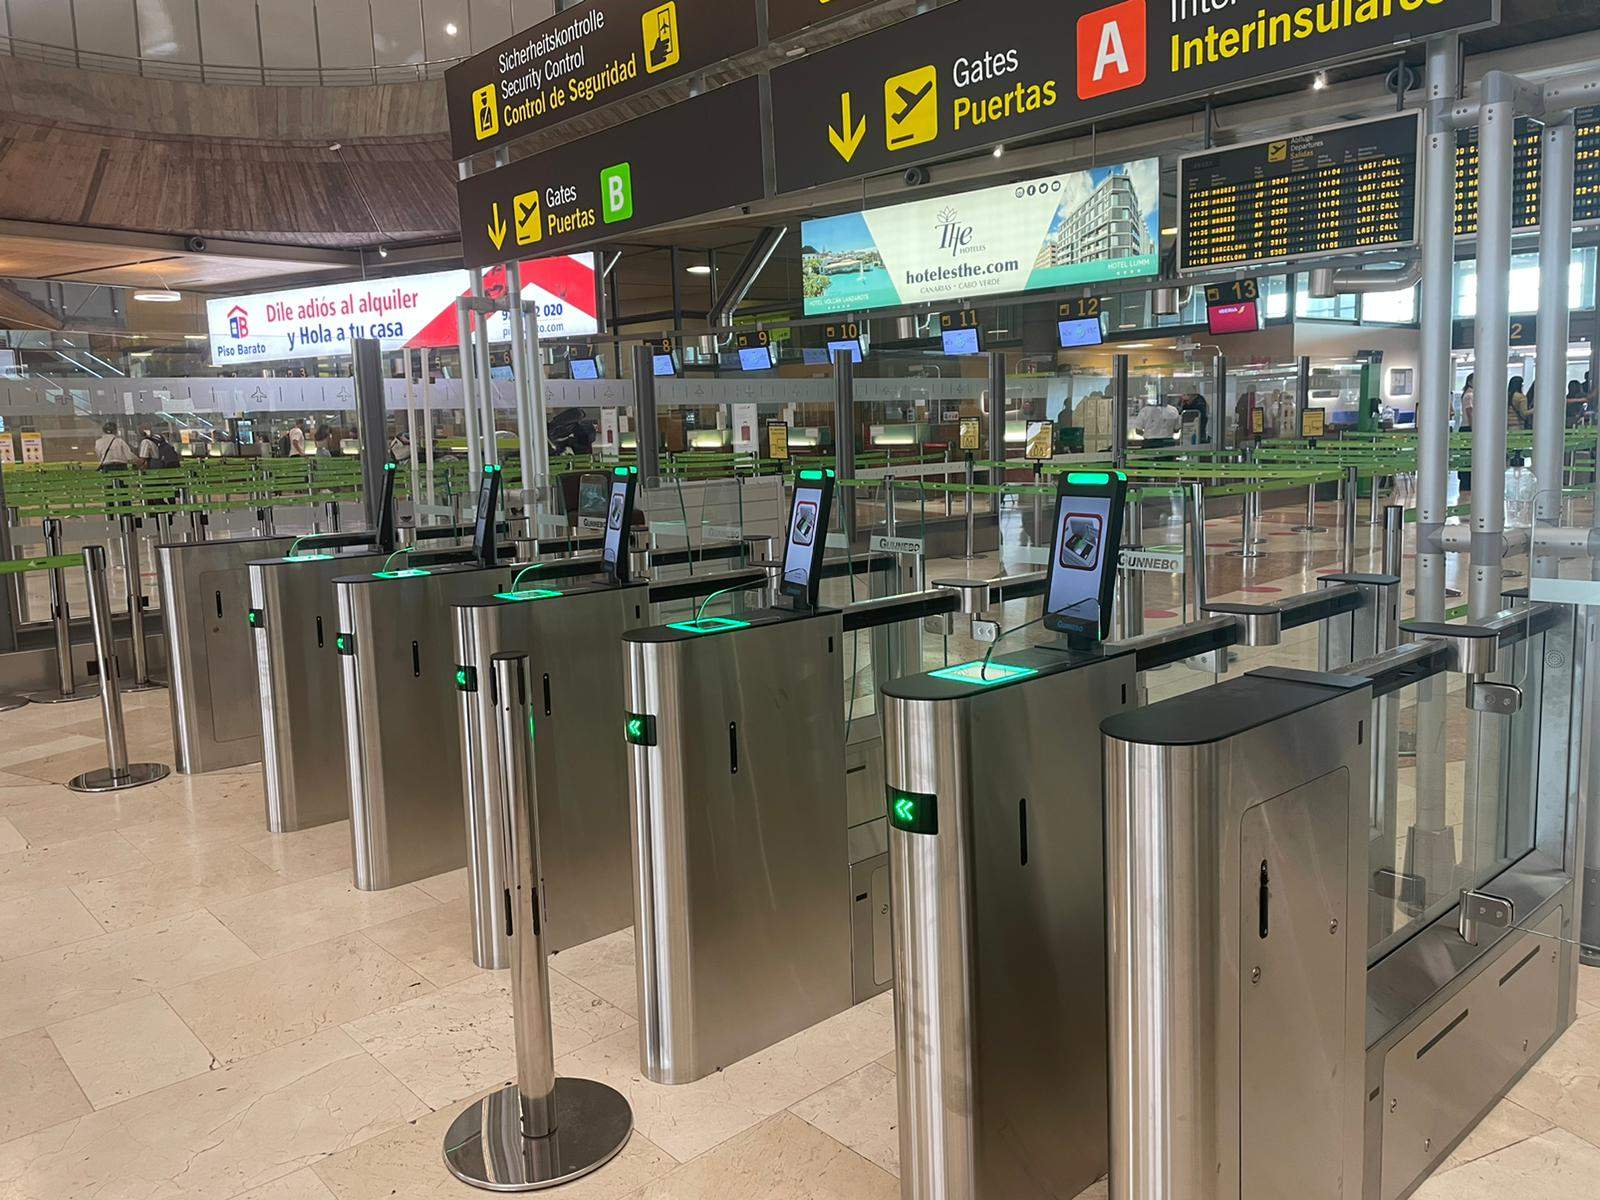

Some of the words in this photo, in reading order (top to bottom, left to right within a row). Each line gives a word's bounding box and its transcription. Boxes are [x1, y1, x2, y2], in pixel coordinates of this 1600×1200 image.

[499, 9, 605, 74] Sicherheitskontrolle
[1171, 0, 1447, 72] Interinsular
[1093, 22, 1129, 82] A
[501, 68, 542, 100] Security
[544, 45, 585, 81] Control
[953, 49, 1019, 88] Gates
[504, 91, 546, 127] Control
[550, 86, 566, 110] de
[568, 52, 637, 101] Seguridad
[953, 80, 1057, 131] Puertas
[608, 175, 625, 212] B
[1212, 186, 1235, 196] MADRID
[1319, 168, 1340, 177] 14:04
[1212, 196, 1235, 205] MADRID
[1319, 179, 1340, 188] 14:04
[545, 185, 577, 208] Gates
[1212, 206, 1235, 215] MADRID
[1318, 189, 1340, 198] 14:04
[547, 208, 596, 236] Puertas
[1212, 215, 1235, 224] MADRID
[1318, 200, 1340, 209] 14:04
[1212, 226, 1235, 234] MADRID
[1318, 210, 1339, 219] 14:04
[1212, 235, 1235, 243] MADRID
[1318, 220, 1339, 229] 14:04
[1212, 244, 1246, 254] BARCELONA
[1317, 231, 1339, 240] 14:05
[960, 245, 986, 254] HOTELES
[1212, 253, 1246, 263] BARCELONA
[1317, 241, 1338, 250] 14:05
[906, 259, 1019, 285] hotelesthe.com
[919, 283, 951, 294] CANARIAS
[958, 279, 977, 289] CABO
[979, 277, 1001, 288] VERDE
[1232, 280, 1257, 300] 13
[266, 302, 294, 322] Dile
[298, 296, 336, 319] adiós
[341, 294, 354, 315] al
[359, 288, 418, 317] alquiler
[543, 303, 563, 317] 020
[1078, 298, 1099, 317] 12
[959, 309, 978, 327] 11
[287, 332, 296, 351] y
[300, 323, 332, 345] Hola
[336, 327, 345, 338] a
[350, 323, 364, 340] tu
[370, 321, 404, 339] casa
[758, 331, 767, 346] 9
[840, 323, 857, 339] 10
[217, 345, 235, 357] Piso
[237, 342, 266, 355] Barato
[663, 339, 671, 352] 8
[503, 351, 511, 364] 6
[880, 538, 920, 552] GUNNEBO
[1117, 552, 1179, 570] GUNNEBO
